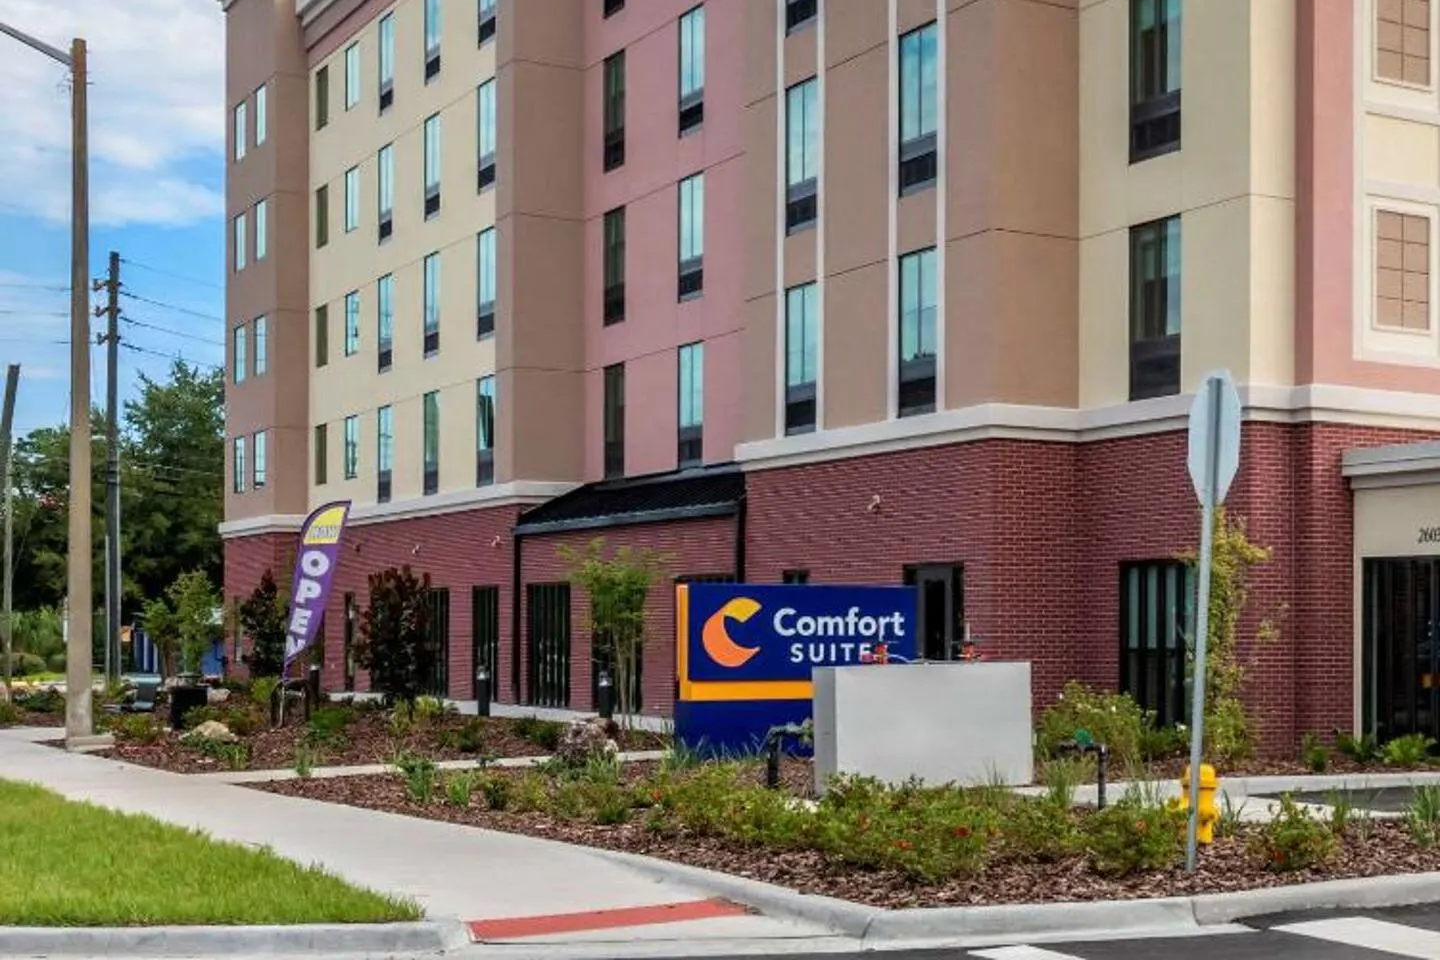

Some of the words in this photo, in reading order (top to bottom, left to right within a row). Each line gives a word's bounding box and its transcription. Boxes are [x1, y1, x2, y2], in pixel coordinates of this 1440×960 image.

[285, 550, 330, 658] OPEN
[773, 607, 905, 637] Comfort
[790, 642, 889, 664] SUITE
